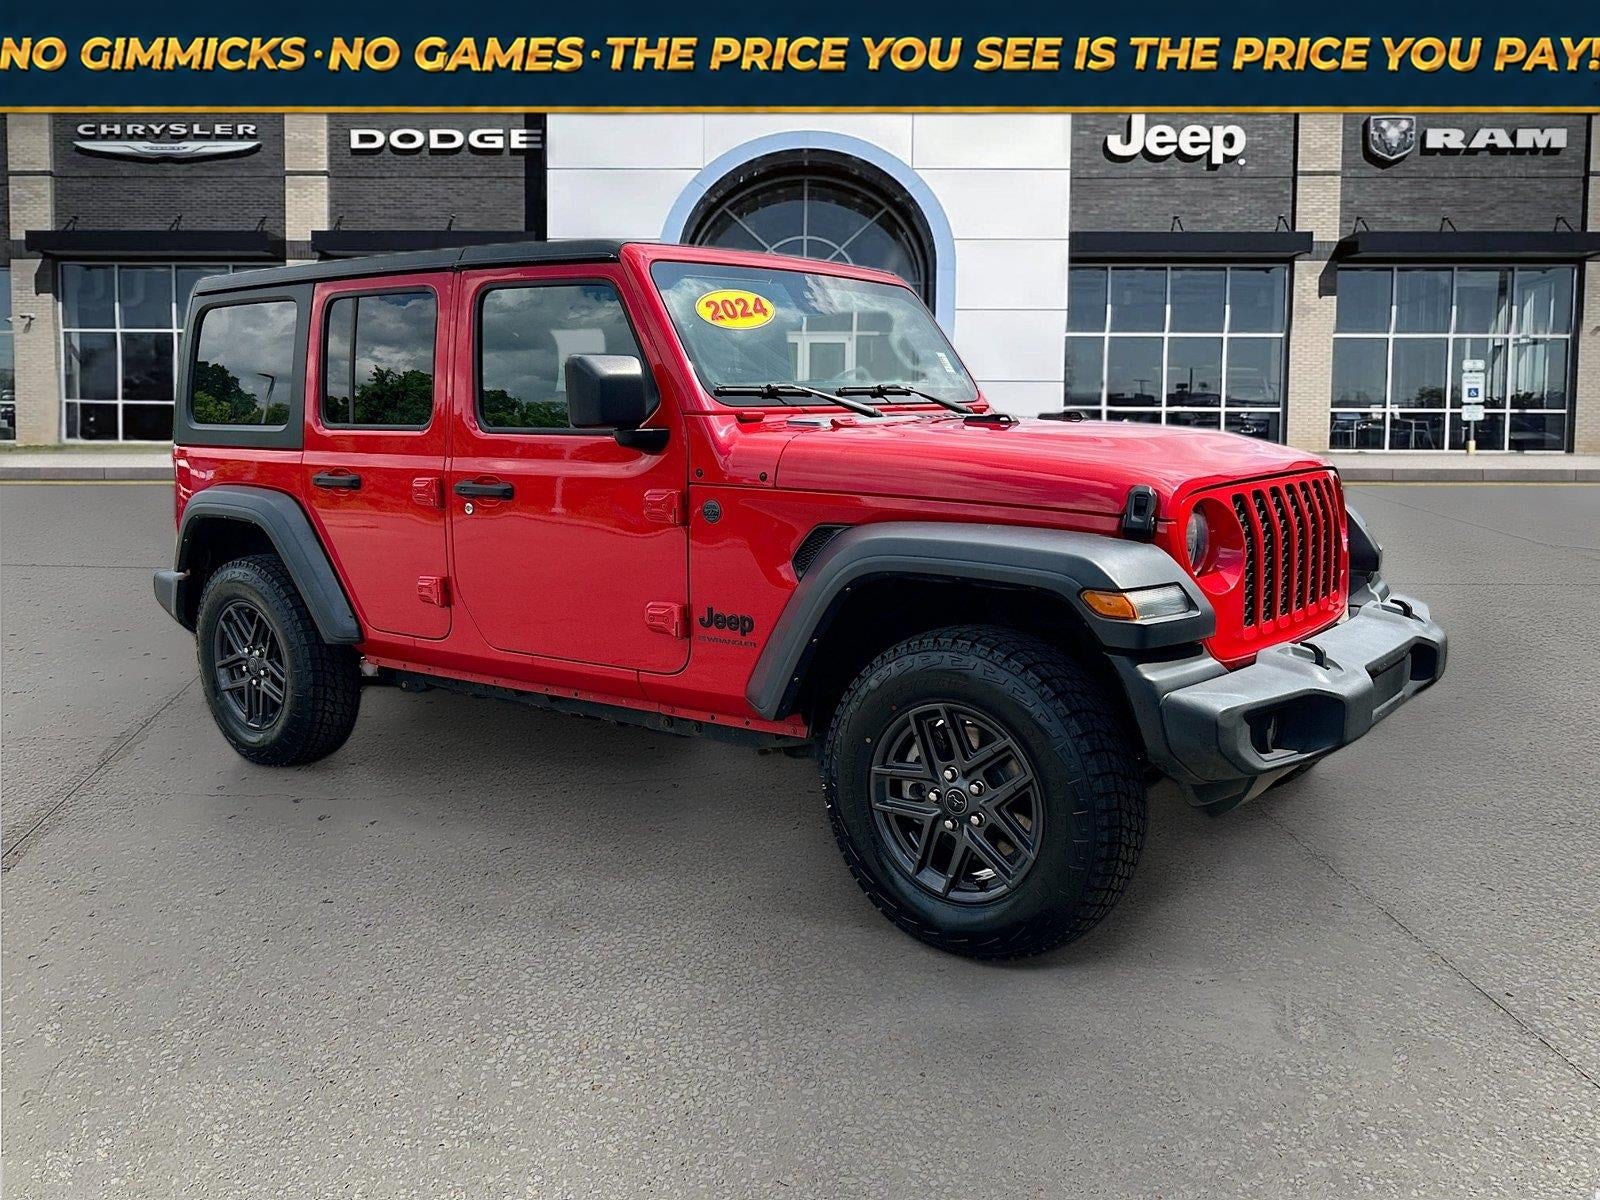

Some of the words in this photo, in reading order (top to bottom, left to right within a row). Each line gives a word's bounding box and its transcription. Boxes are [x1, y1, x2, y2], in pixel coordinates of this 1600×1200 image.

[76, 123, 258, 137] CHRYSLER
[350, 128, 544, 151] DODGE
[1106, 114, 1247, 166] Jeep
[1425, 127, 1568, 150] RAM
[705, 297, 768, 321] 2024
[699, 606, 755, 637] Jeep
[707, 636, 757, 648] WRANGLER
